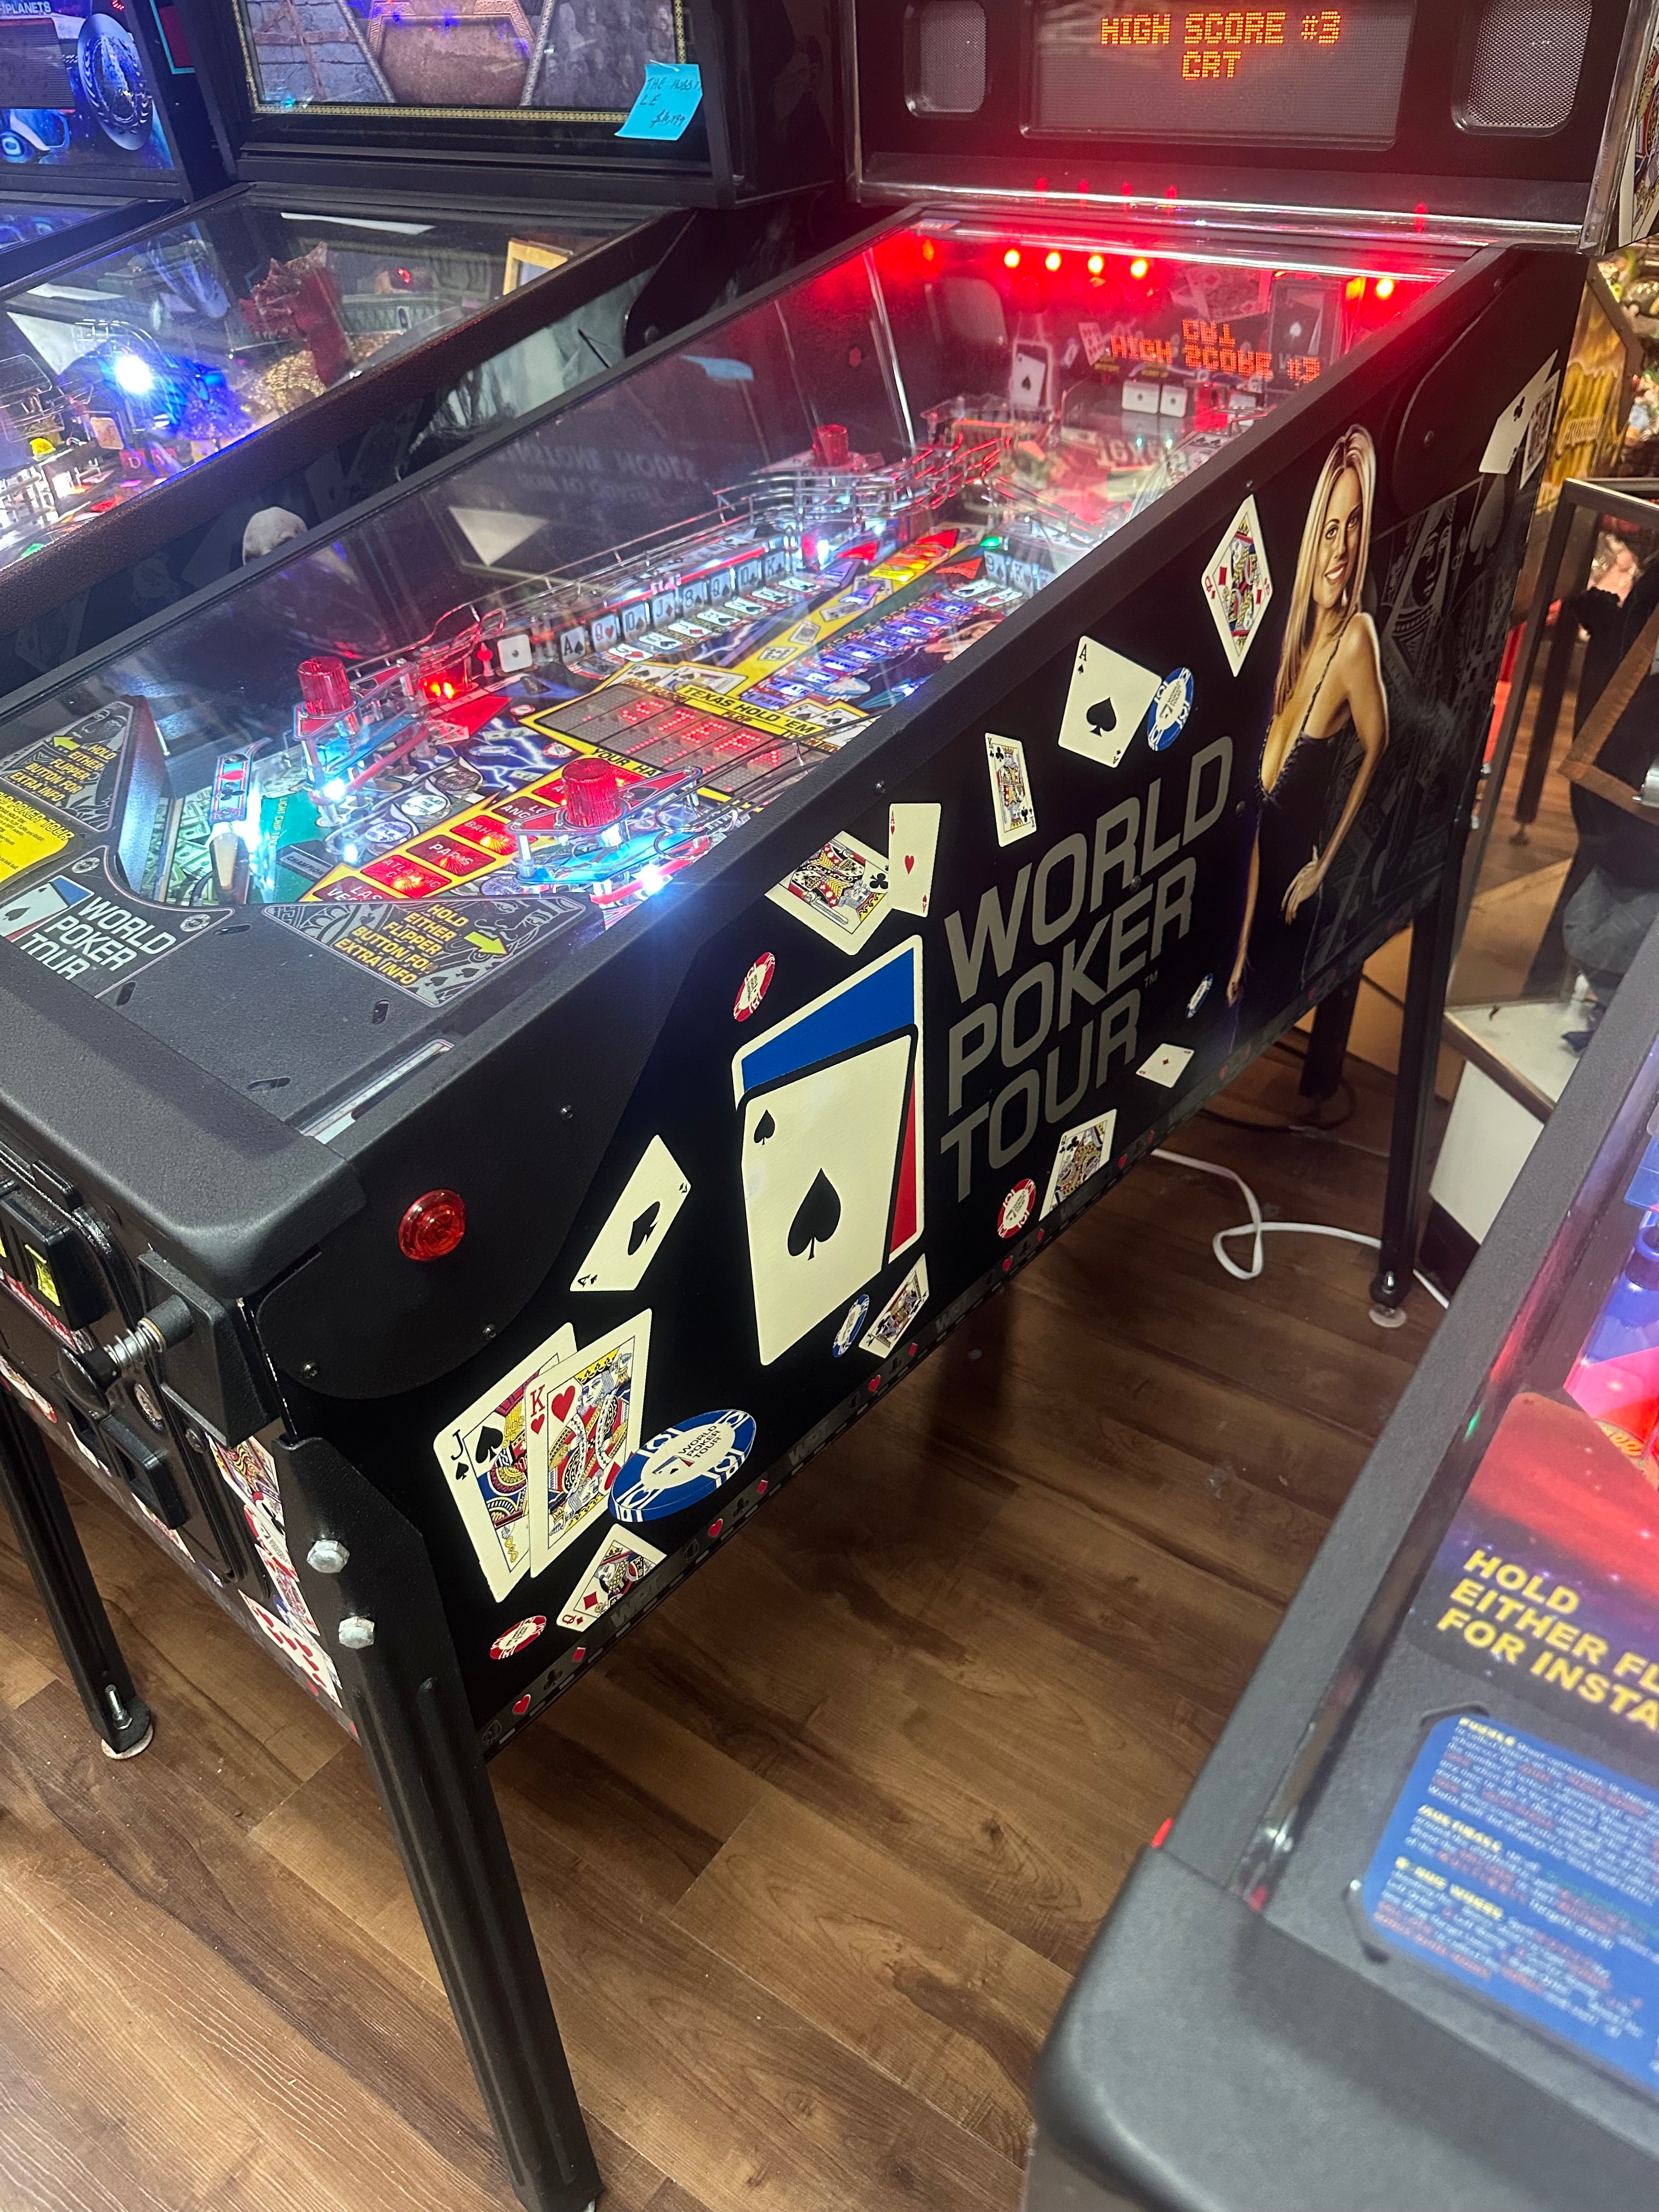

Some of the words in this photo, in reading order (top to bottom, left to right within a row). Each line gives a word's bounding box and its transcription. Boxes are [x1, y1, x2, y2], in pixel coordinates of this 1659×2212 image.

[1101, 13, 1170, 45] HIGH
[1184, 11, 1286, 44] SCORE
[1301, 10, 1341, 44] #3
[1182, 50, 1242, 81] CRT
[563, 634, 574, 656] A
[1079, 644, 1087, 662] A
[685, 687, 735, 707] TEXAS
[733, 703, 781, 722] HOLD
[785, 719, 817, 734] 'EM
[67, 751, 105, 771] EITHER
[87, 744, 117, 760] HOLD
[591, 748, 631, 766] YOUR
[633, 765, 658, 777] HA
[25, 763, 65, 784] BUTTON
[61, 780, 83, 794] FOR
[49, 758, 92, 780] FLIPPER
[10, 771, 43, 791] EXTRA
[37, 786, 66, 802] INFO
[7, 800, 46, 823] POKER
[40, 819, 75, 841] TOUR
[890, 810, 895, 825] A
[286, 855, 326, 877] CHAMPION
[430, 843, 475, 866] PARIS
[944, 736, 1234, 1003] WORLD
[78, 896, 177, 955] WORLD
[404, 912, 457, 943] EITHER
[427, 904, 469, 927] HOLD
[44, 915, 137, 972] POKER
[352, 926, 410, 959] BUTTON
[382, 922, 443, 955] FLIPPER
[20, 932, 91, 980] TOUR
[334, 938, 383, 967] EXTRA
[378, 961, 418, 985] INFO
[949, 856, 1197, 1116] POKER
[940, 988, 1141, 1203] TOUR
[577, 1273, 591, 1288] A
[530, 1384, 546, 1418] K
[450, 1429, 464, 1461] J
[678, 1425, 717, 1454] WORLD
[686, 1430, 721, 1457] POKER
[692, 1437, 722, 1458] TOUR
[1463, 1549, 1581, 1615] HOLD
[562, 1614, 577, 1625] Q
[1450, 1578, 1609, 1666] EITHER
[1436, 1607, 1527, 1666] FOR
[1530, 1650, 1659, 1732] INSTA
